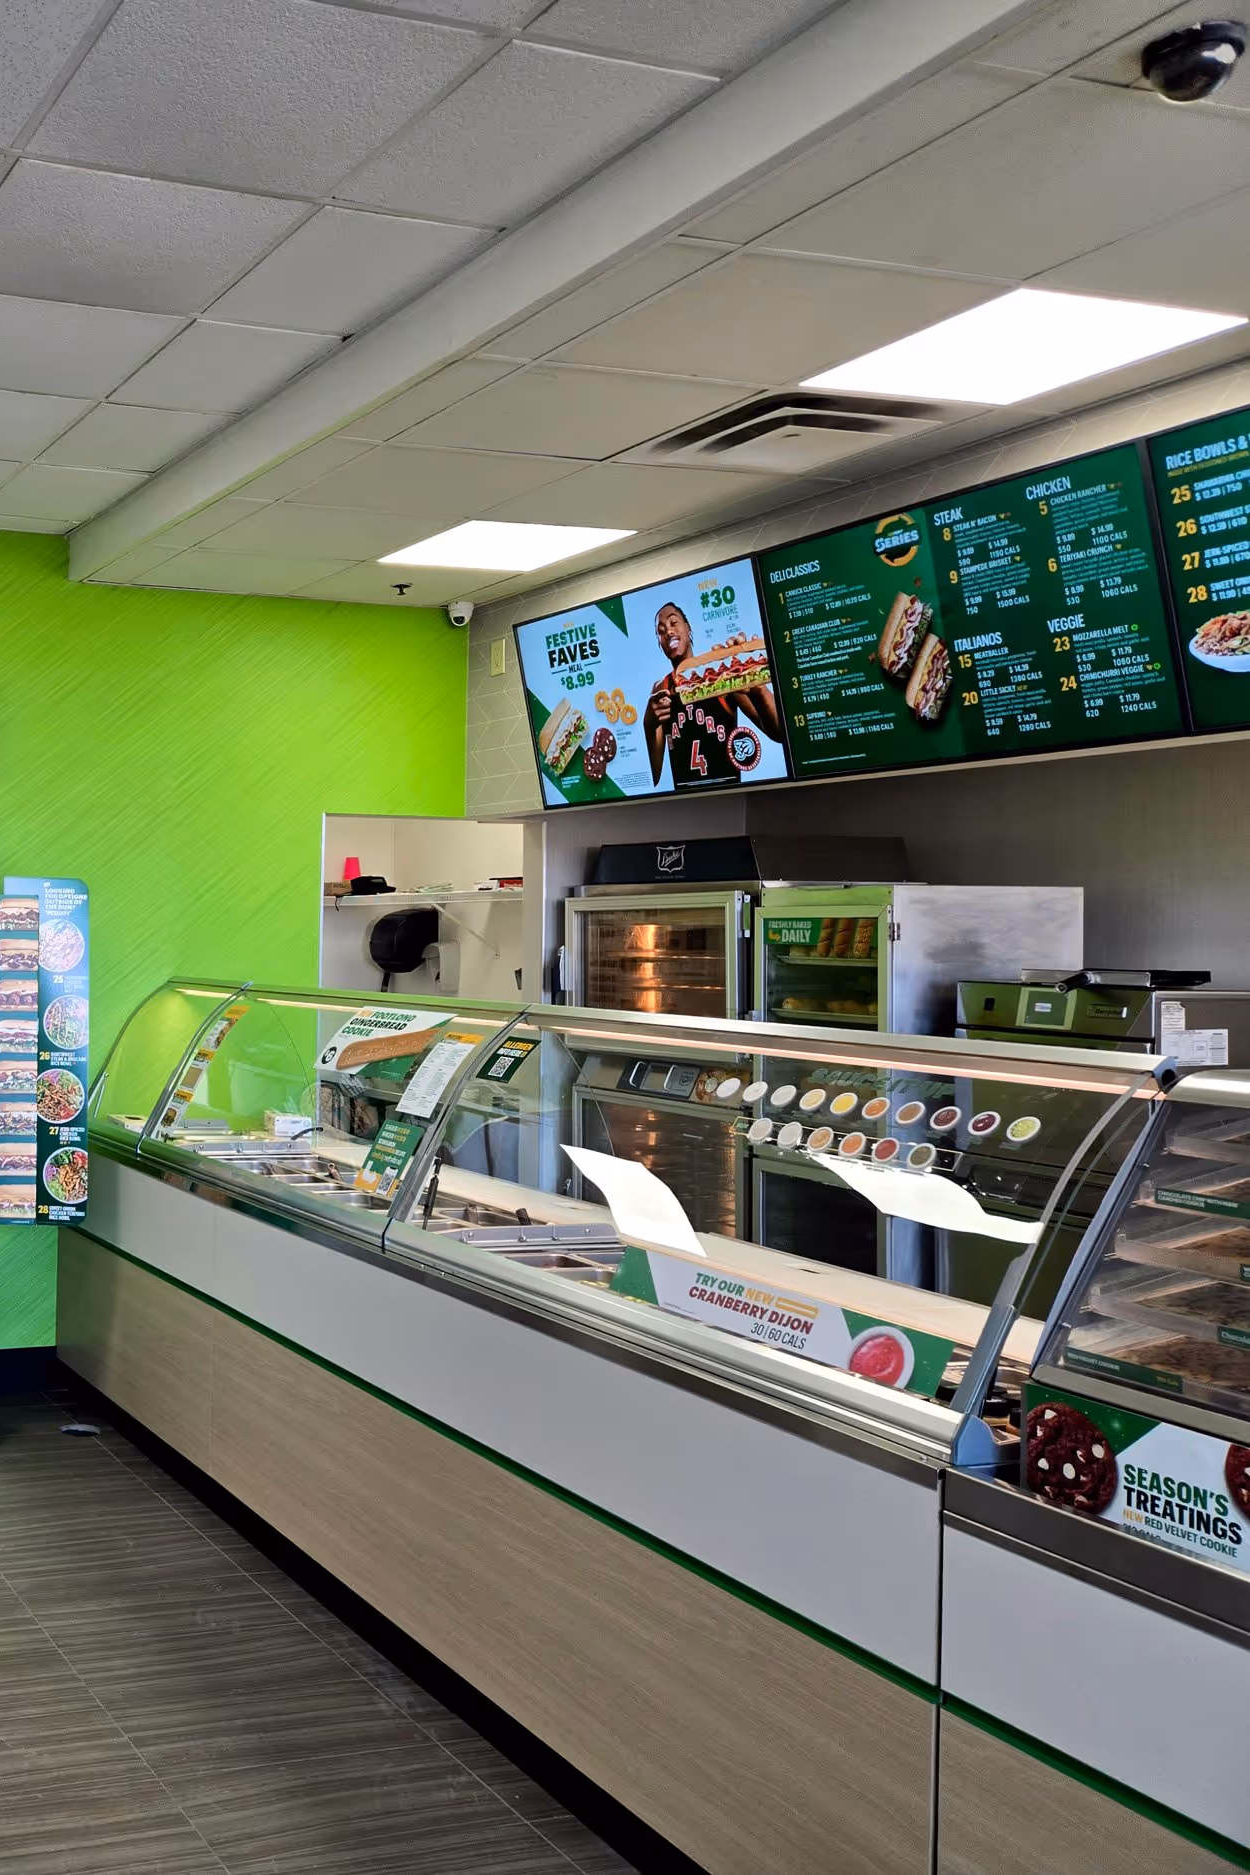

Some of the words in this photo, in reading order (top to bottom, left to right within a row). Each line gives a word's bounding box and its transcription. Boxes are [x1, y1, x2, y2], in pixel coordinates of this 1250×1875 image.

[1165, 450, 1192, 471] RICE
[1194, 439, 1236, 462] BOWLS
[1238, 435, 1247, 450] &
[1026, 476, 1071, 500] CHICKEN
[1171, 485, 1191, 504] 25
[1039, 500, 1048, 515] 5
[1050, 492, 1077, 506] CHICKEN
[1077, 484, 1106, 497] RANCHER
[934, 507, 963, 526] STEAK
[1176, 519, 1197, 537] 26
[1199, 507, 1244, 525] SOUTHWEST
[943, 528, 951, 541] 8
[953, 521, 970, 532] STEAK
[977, 514, 997, 525] BACON
[875, 530, 919, 552] SERIES
[1005, 545, 1020, 555] CALS
[1058, 545, 1071, 554] 550
[1093, 536, 1109, 545] 1100
[1110, 531, 1127, 541] CALS
[1048, 558, 1057, 572] 6
[1060, 550, 1086, 563] TERIYAKI
[1087, 545, 1113, 556] CRUNCH
[1182, 552, 1199, 570] 27
[770, 572, 785, 583] DELI
[786, 560, 820, 579] CLASSICS
[950, 570, 958, 584] 9
[989, 557, 1011, 568] BRISKET
[698, 578, 718, 590] NEW
[779, 593, 784, 604] 1
[785, 588, 802, 597] CANUCK
[803, 583, 821, 593] CLASSIC
[1120, 584, 1138, 594] CALS
[1187, 585, 1208, 603] 28
[1210, 580, 1234, 591] SWEET
[701, 585, 735, 608] #30
[859, 593, 871, 602] CALS
[966, 607, 978, 615] 750
[998, 599, 1012, 608] 1500
[1014, 595, 1030, 605] CALS
[702, 604, 738, 621] CARNIVORE
[784, 631, 790, 642] 2
[806, 623, 828, 632] CANADIAN
[829, 619, 840, 627] CLUB
[1047, 614, 1085, 633] VEGGIE
[545, 623, 597, 649] FESTIVE
[954, 632, 1002, 652] ITALIANOS
[1053, 636, 1070, 652] 23
[1073, 628, 1112, 642] MOZZARELLA
[1113, 625, 1128, 634] MELT
[548, 639, 600, 668] FAVES
[958, 654, 972, 668] 15
[974, 647, 1009, 659] MEATBALLER
[1078, 664, 1091, 672] 530
[1132, 654, 1149, 663] CALS
[568, 663, 583, 673] MEAL
[1027, 671, 1042, 680] CALS
[1060, 676, 1077, 691] 24
[1080, 670, 1120, 681] CHIMICHURRI
[1121, 665, 1144, 675] VEGGIE
[561, 671, 595, 690] $8.99
[792, 678, 798, 688] 3
[816, 670, 837, 678] RANCHER
[962, 692, 978, 706] 20
[980, 688, 998, 696] LITTLE
[999, 685, 1016, 694] SICILY
[1121, 703, 1138, 712] 1240
[1139, 701, 1157, 710] CALS
[794, 715, 805, 727] 13
[1035, 721, 1051, 730] CALS
[690, 740, 707, 776] 4
[782, 929, 811, 942] DAILY
[350, 1018, 408, 1030] GINGERBREAD
[372, 1012, 416, 1021] FOOTLONG
[342, 1028, 374, 1036] COOKIE
[39, 1052, 50, 1060] 26
[807, 1068, 889, 1090] SAUCE
[49, 1127, 59, 1135] 27
[38, 1205, 48, 1213] 28
[695, 1272, 718, 1288] TRY
[718, 1280, 745, 1297] OUR
[745, 1288, 774, 1304] NEW
[689, 1286, 769, 1320] CRANBERRY
[768, 1311, 814, 1335] DIJON
[782, 1335, 806, 1349] CALS
[1123, 1464, 1229, 1517] SEASON'S
[1123, 1486, 1242, 1546] TREATINGS
[1123, 1509, 1143, 1524] NEW
[1144, 1517, 1162, 1531] RED
[1165, 1524, 1198, 1544] VELVET
[1200, 1537, 1238, 1558] COOKIE
